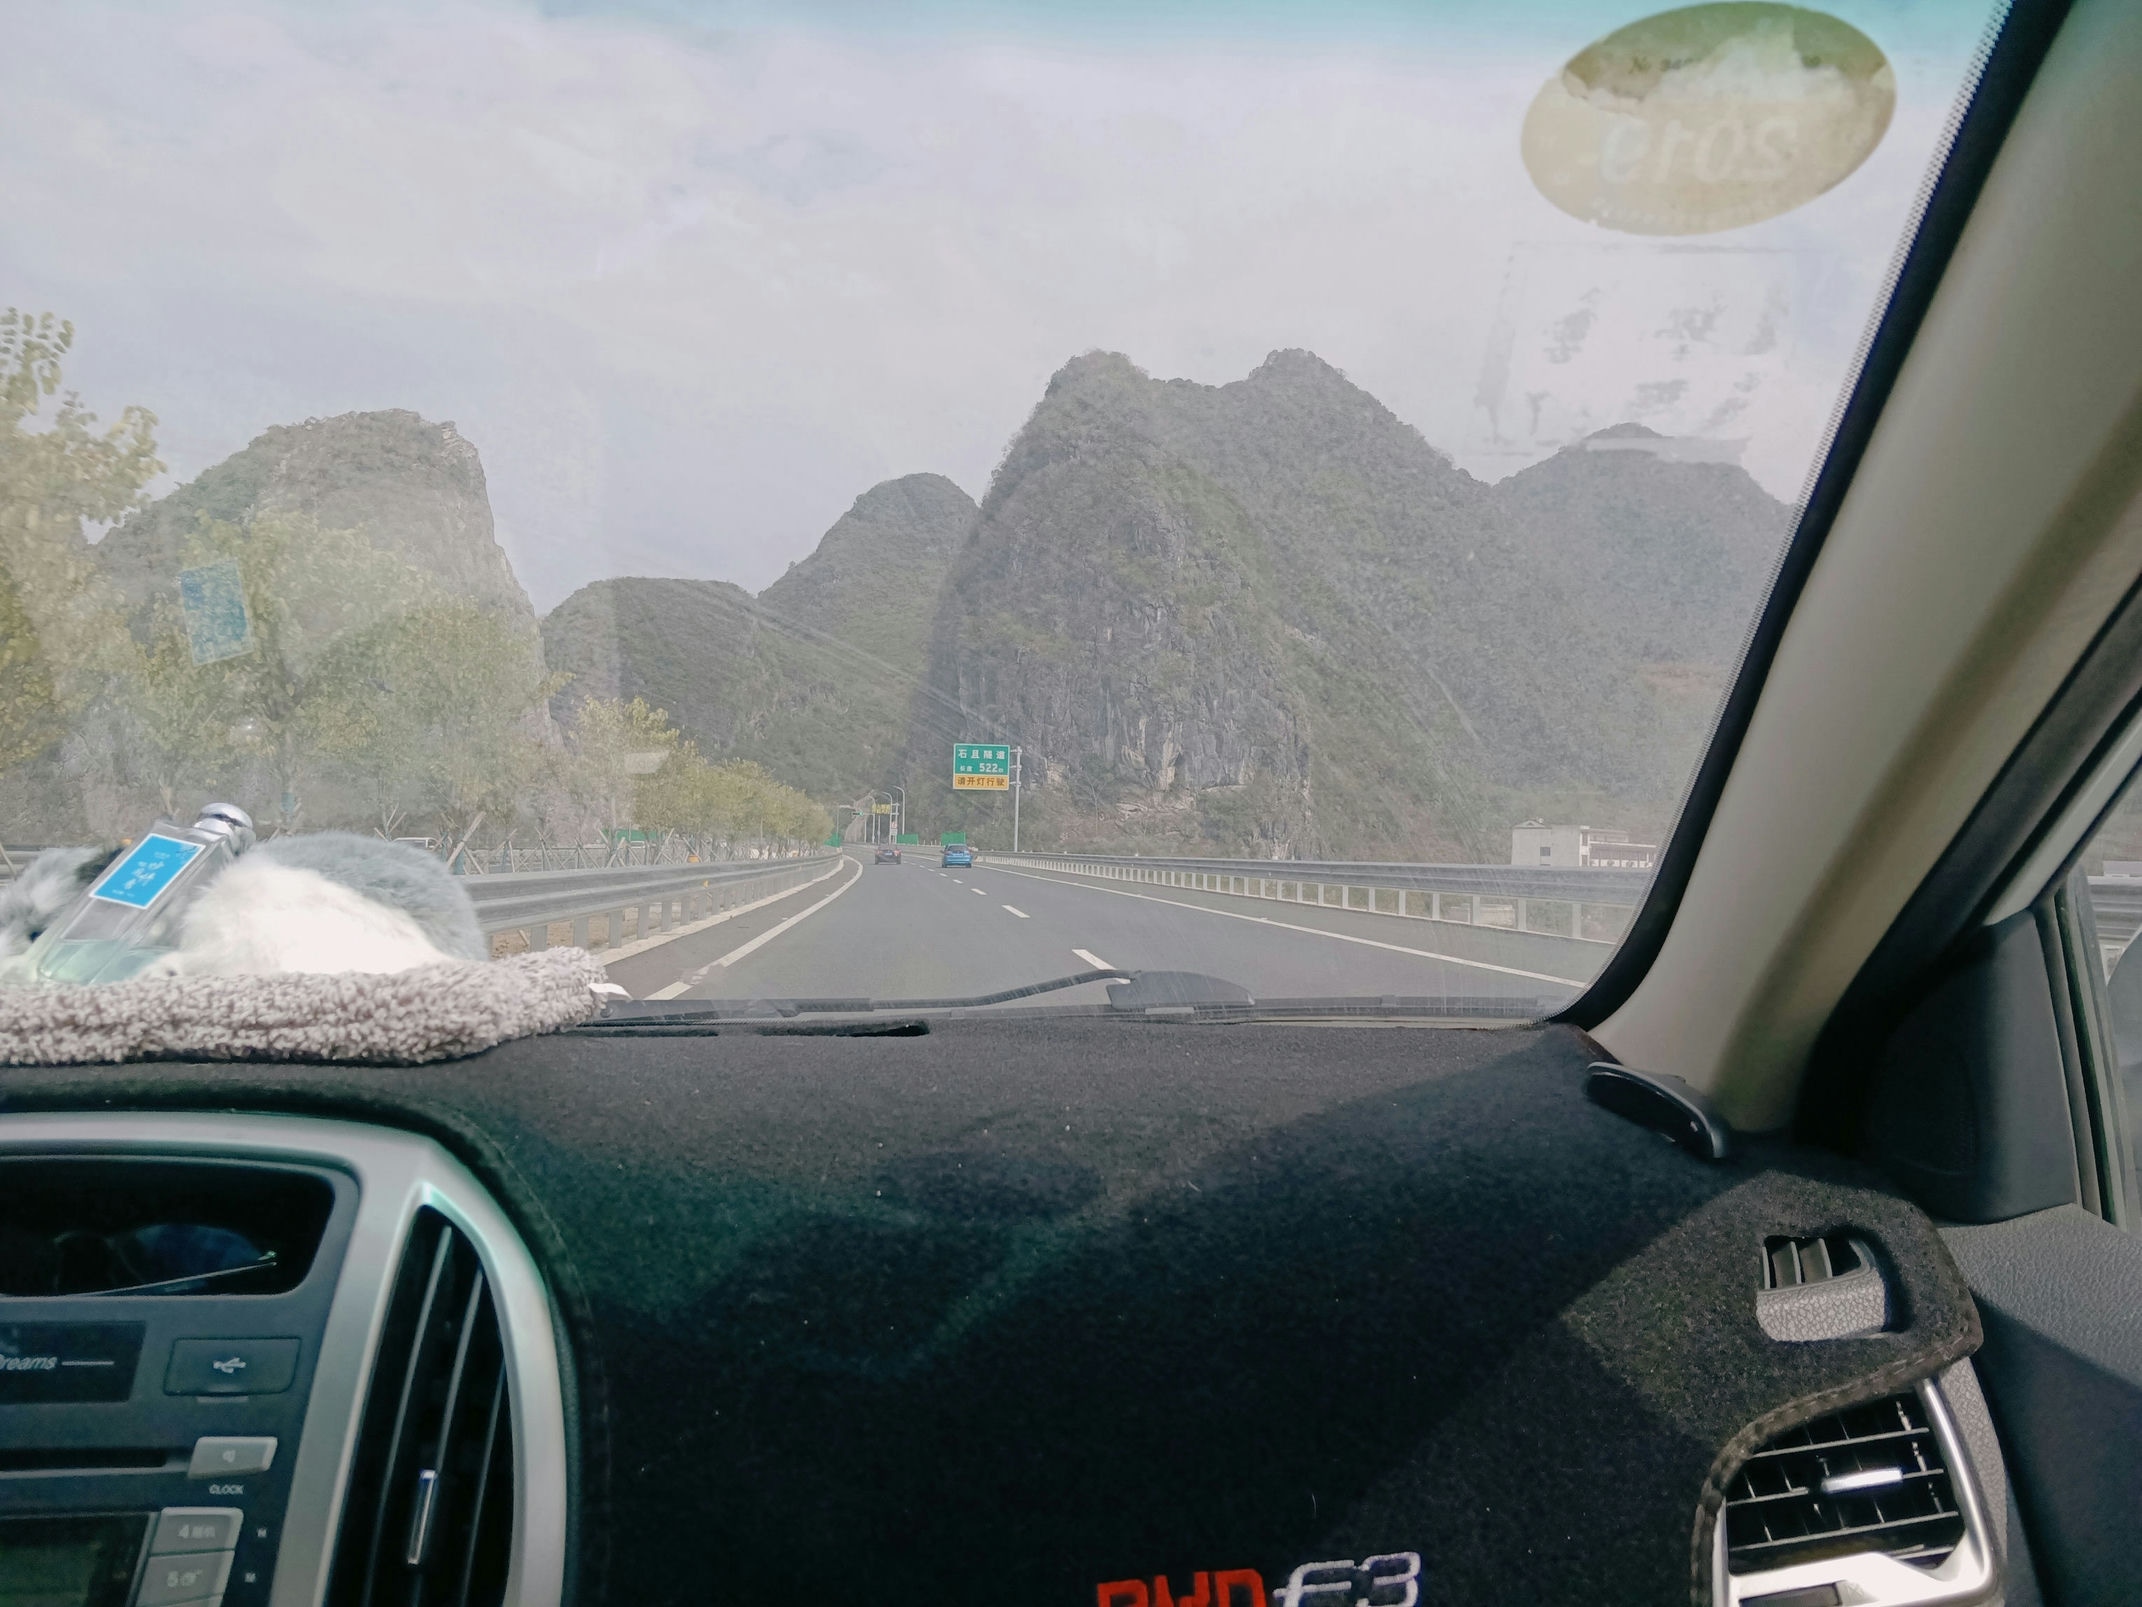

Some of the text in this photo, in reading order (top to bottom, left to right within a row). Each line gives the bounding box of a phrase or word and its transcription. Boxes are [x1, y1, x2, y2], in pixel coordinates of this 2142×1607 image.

[957, 776, 1005, 786] 请开灯行驶
[209, 1484, 244, 1495] CLOCK
